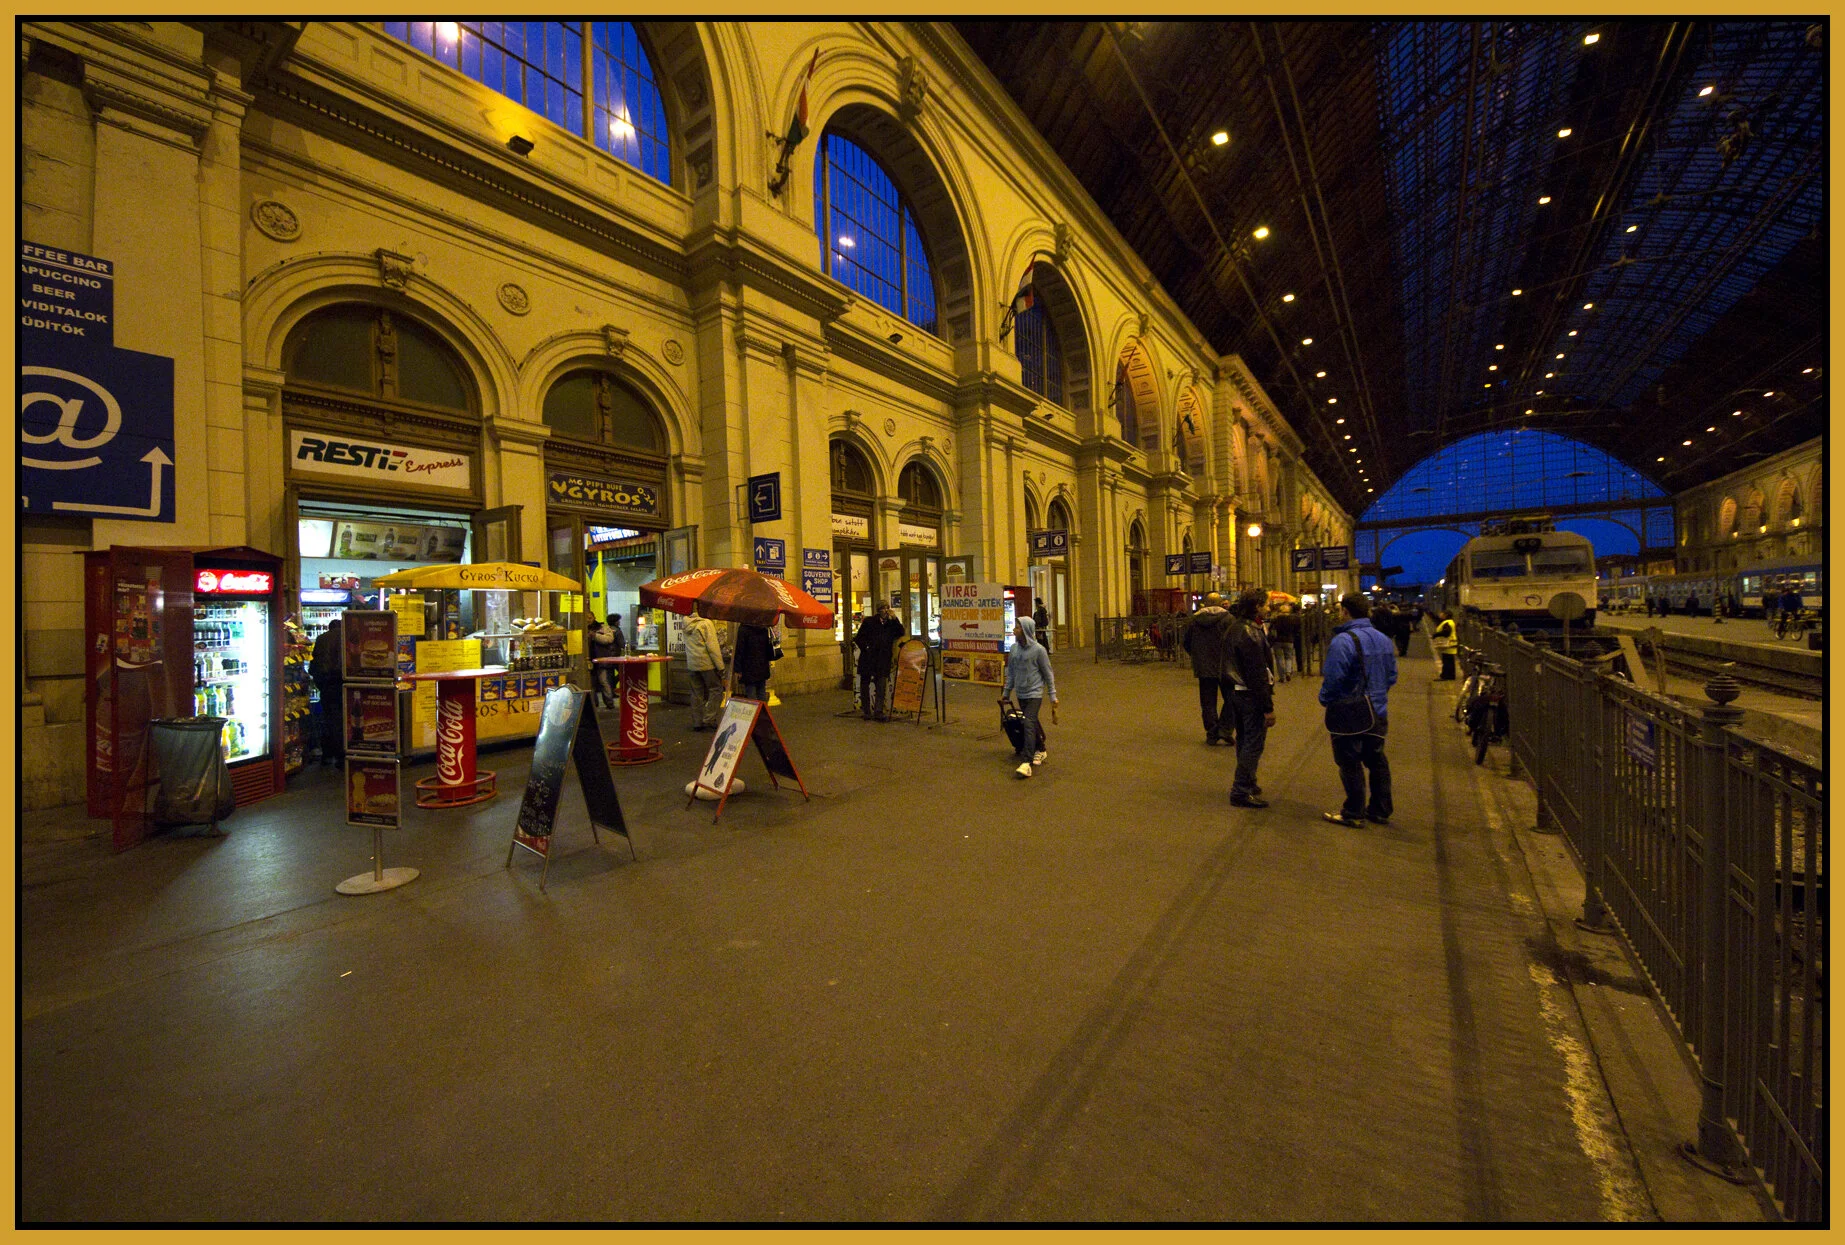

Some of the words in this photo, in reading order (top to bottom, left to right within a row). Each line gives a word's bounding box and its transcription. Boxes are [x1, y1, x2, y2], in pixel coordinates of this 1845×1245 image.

[22, 244, 68, 262] FFEE
[73, 256, 108, 272] BAR
[22, 264, 102, 288] APUCCINO
[32, 284, 76, 300] BEER
[22, 299, 108, 323] VIDITALOK
[406, 458, 463, 474] Express
[568, 486, 640, 506] GYROS
[460, 568, 496, 582] GYROS
[660, 569, 722, 588] Coca-Cola
[804, 570, 831, 578] SOUVENIR
[942, 608, 979, 621] SOUVENIR
[980, 608, 1003, 621] SHOP
[626, 676, 648, 746] Coca-Cola
[437, 698, 464, 785] Coca-Cola
